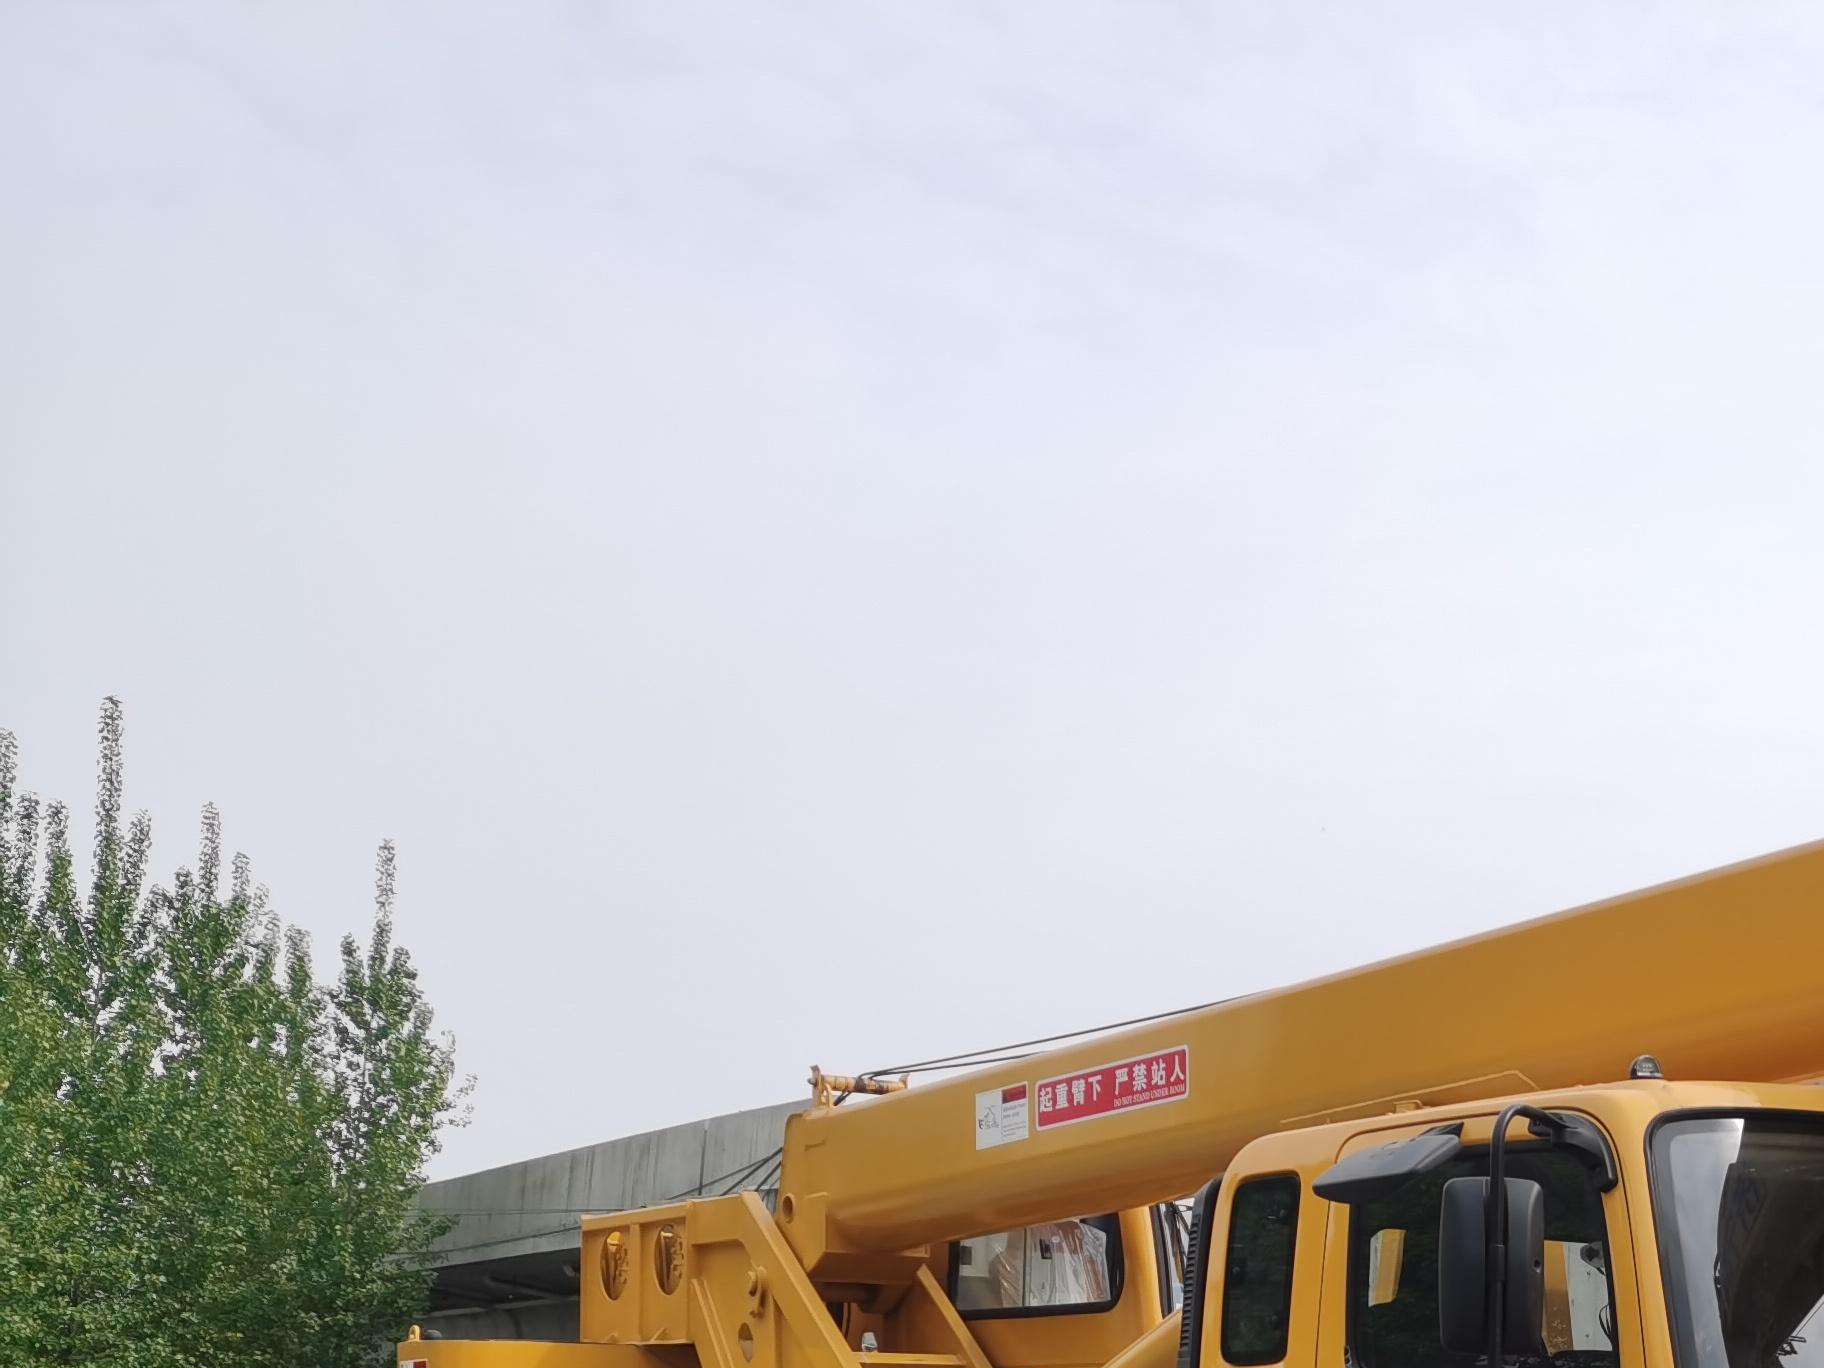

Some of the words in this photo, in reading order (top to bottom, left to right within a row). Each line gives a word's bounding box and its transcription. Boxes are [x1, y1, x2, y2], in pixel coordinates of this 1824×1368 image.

[1039, 1074, 1103, 1113] 起重臂下
[1114, 1054, 1186, 1096] 严禁站人
[1133, 1092, 1150, 1103] STAND
[1150, 1087, 1169, 1099] UNDER
